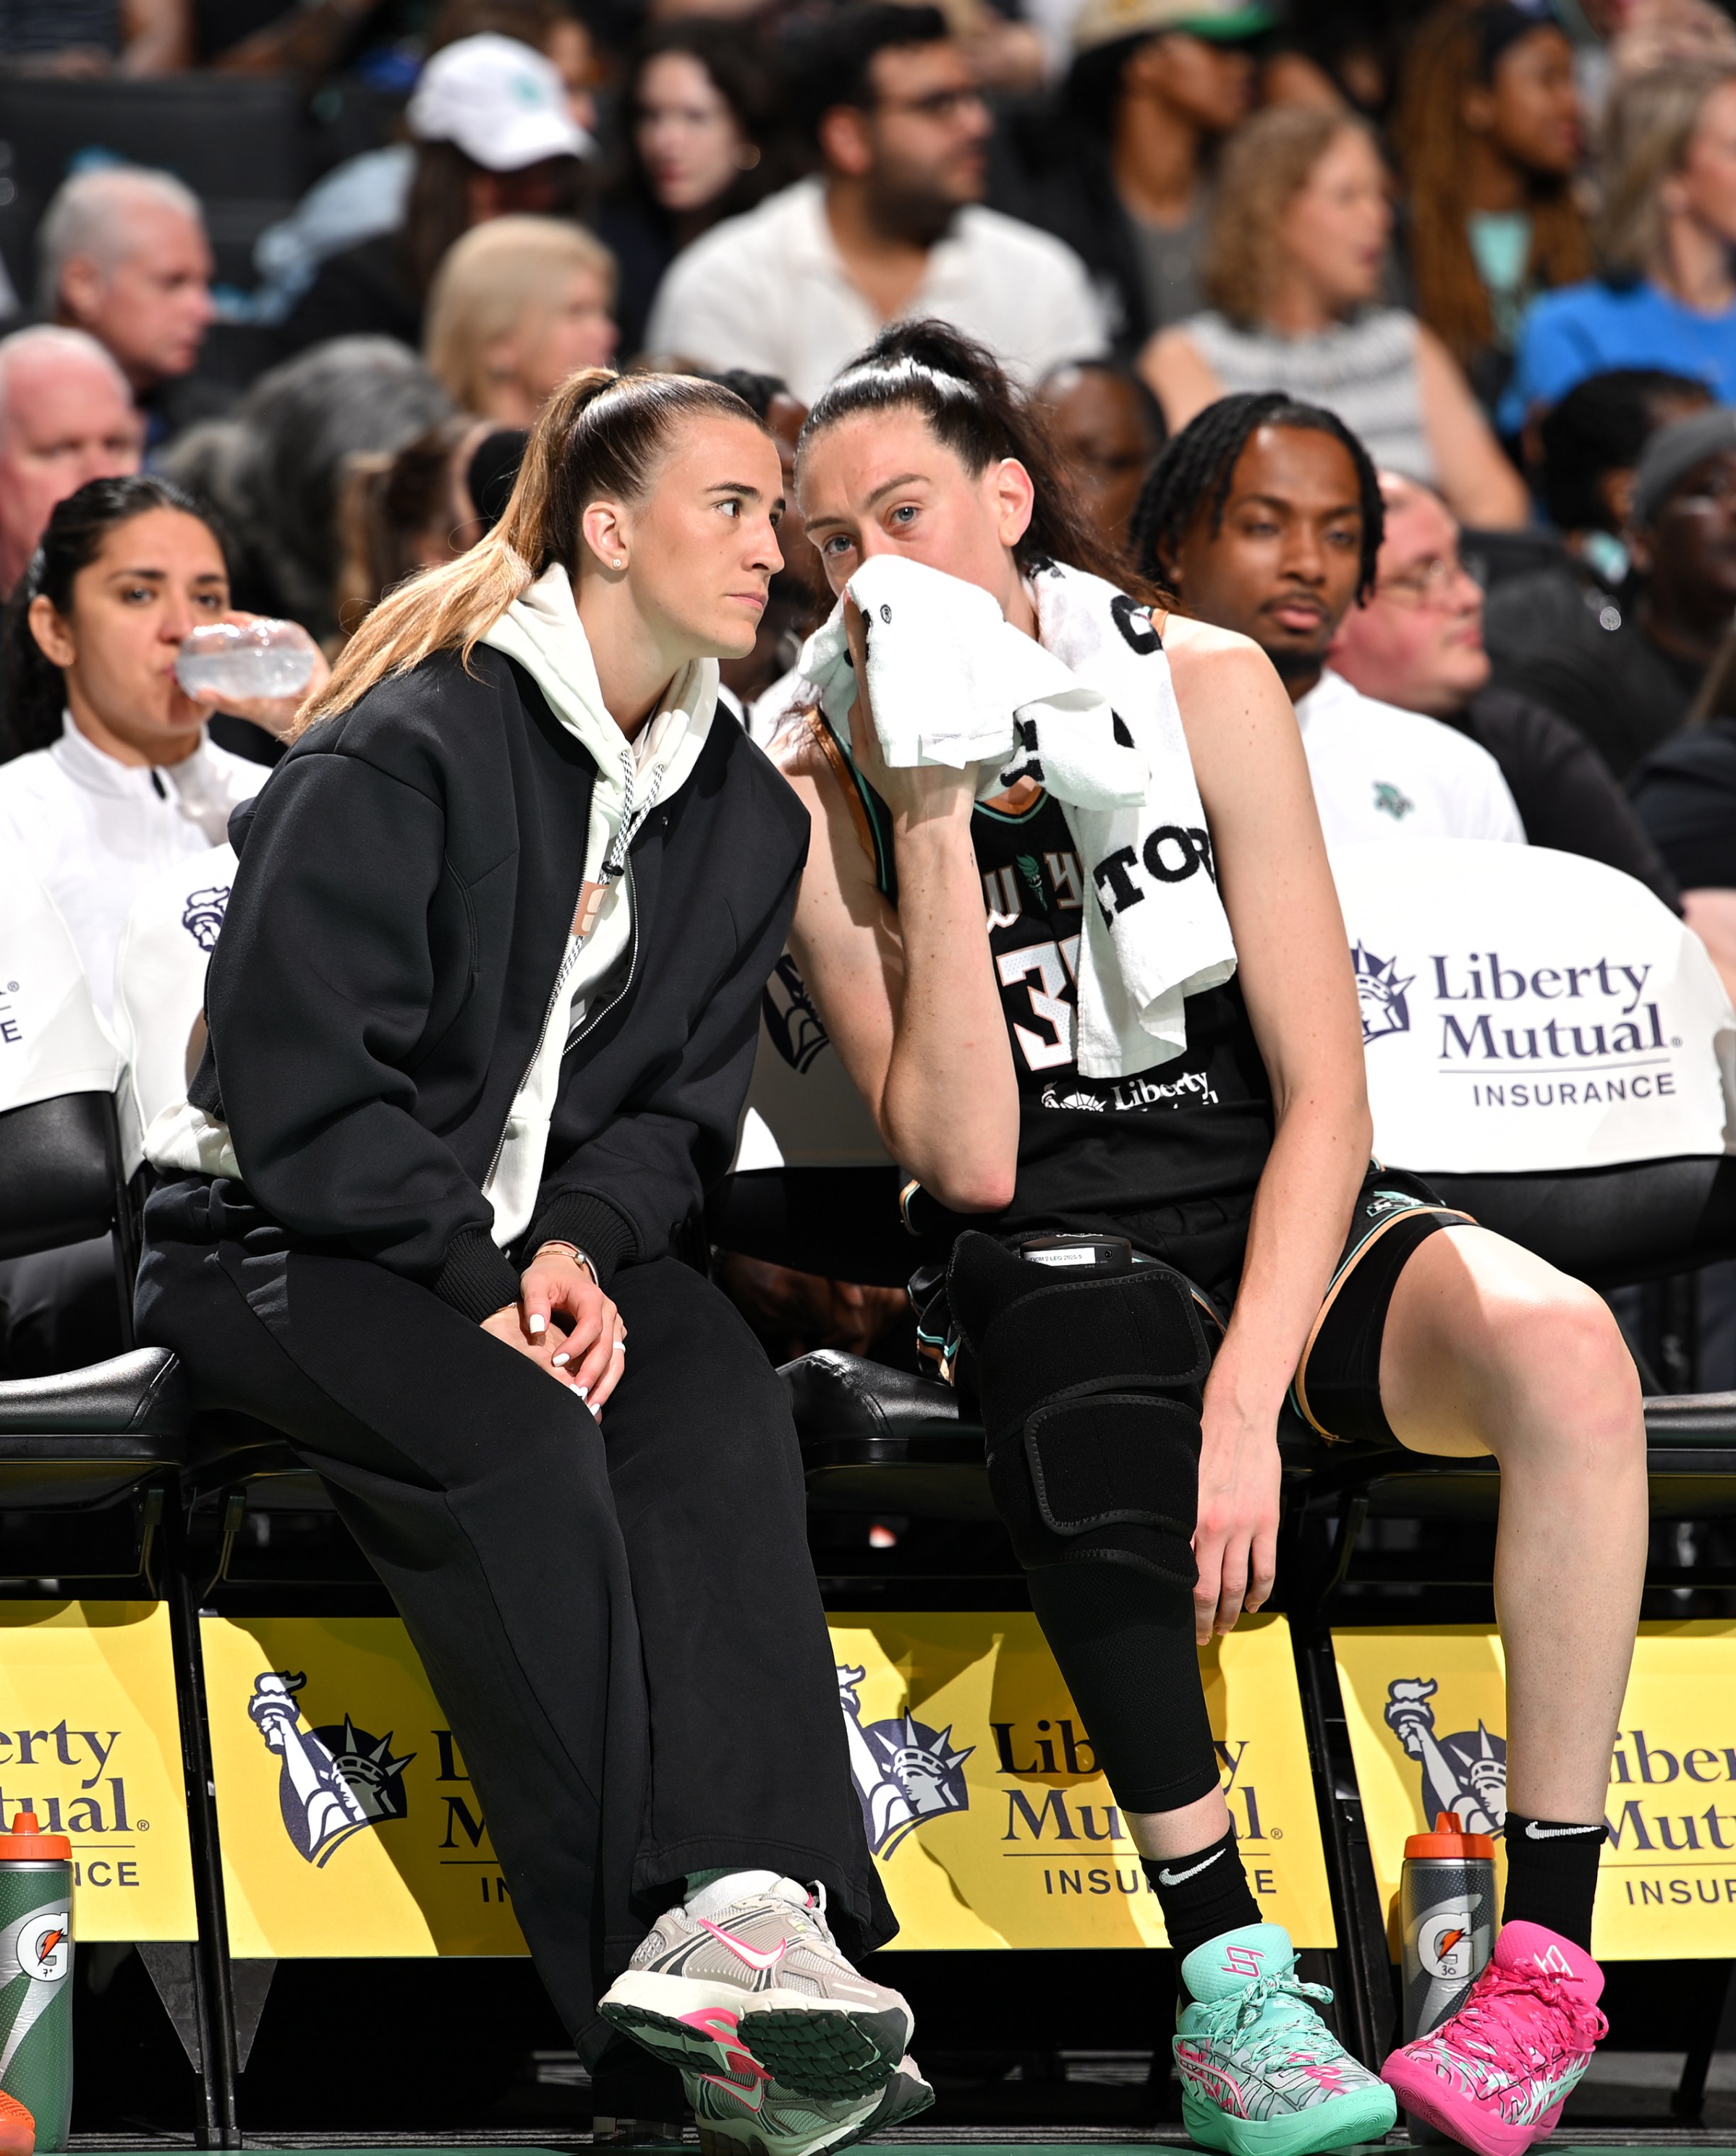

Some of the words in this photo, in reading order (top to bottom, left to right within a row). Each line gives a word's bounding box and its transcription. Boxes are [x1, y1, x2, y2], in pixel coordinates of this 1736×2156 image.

[1092, 825, 1215, 933] TOR
[996, 934, 1082, 1071] 3
[1429, 952, 1652, 1015] Liberty
[1111, 1072, 1207, 1110] Liberty
[1473, 1073, 1676, 1107] INSURANCE
[1609, 1731, 1736, 1784] ibe
[1604, 1801, 1736, 1850] Mut
[1418, 1912, 1474, 1980] G
[1441, 1964, 1457, 1976] 30
